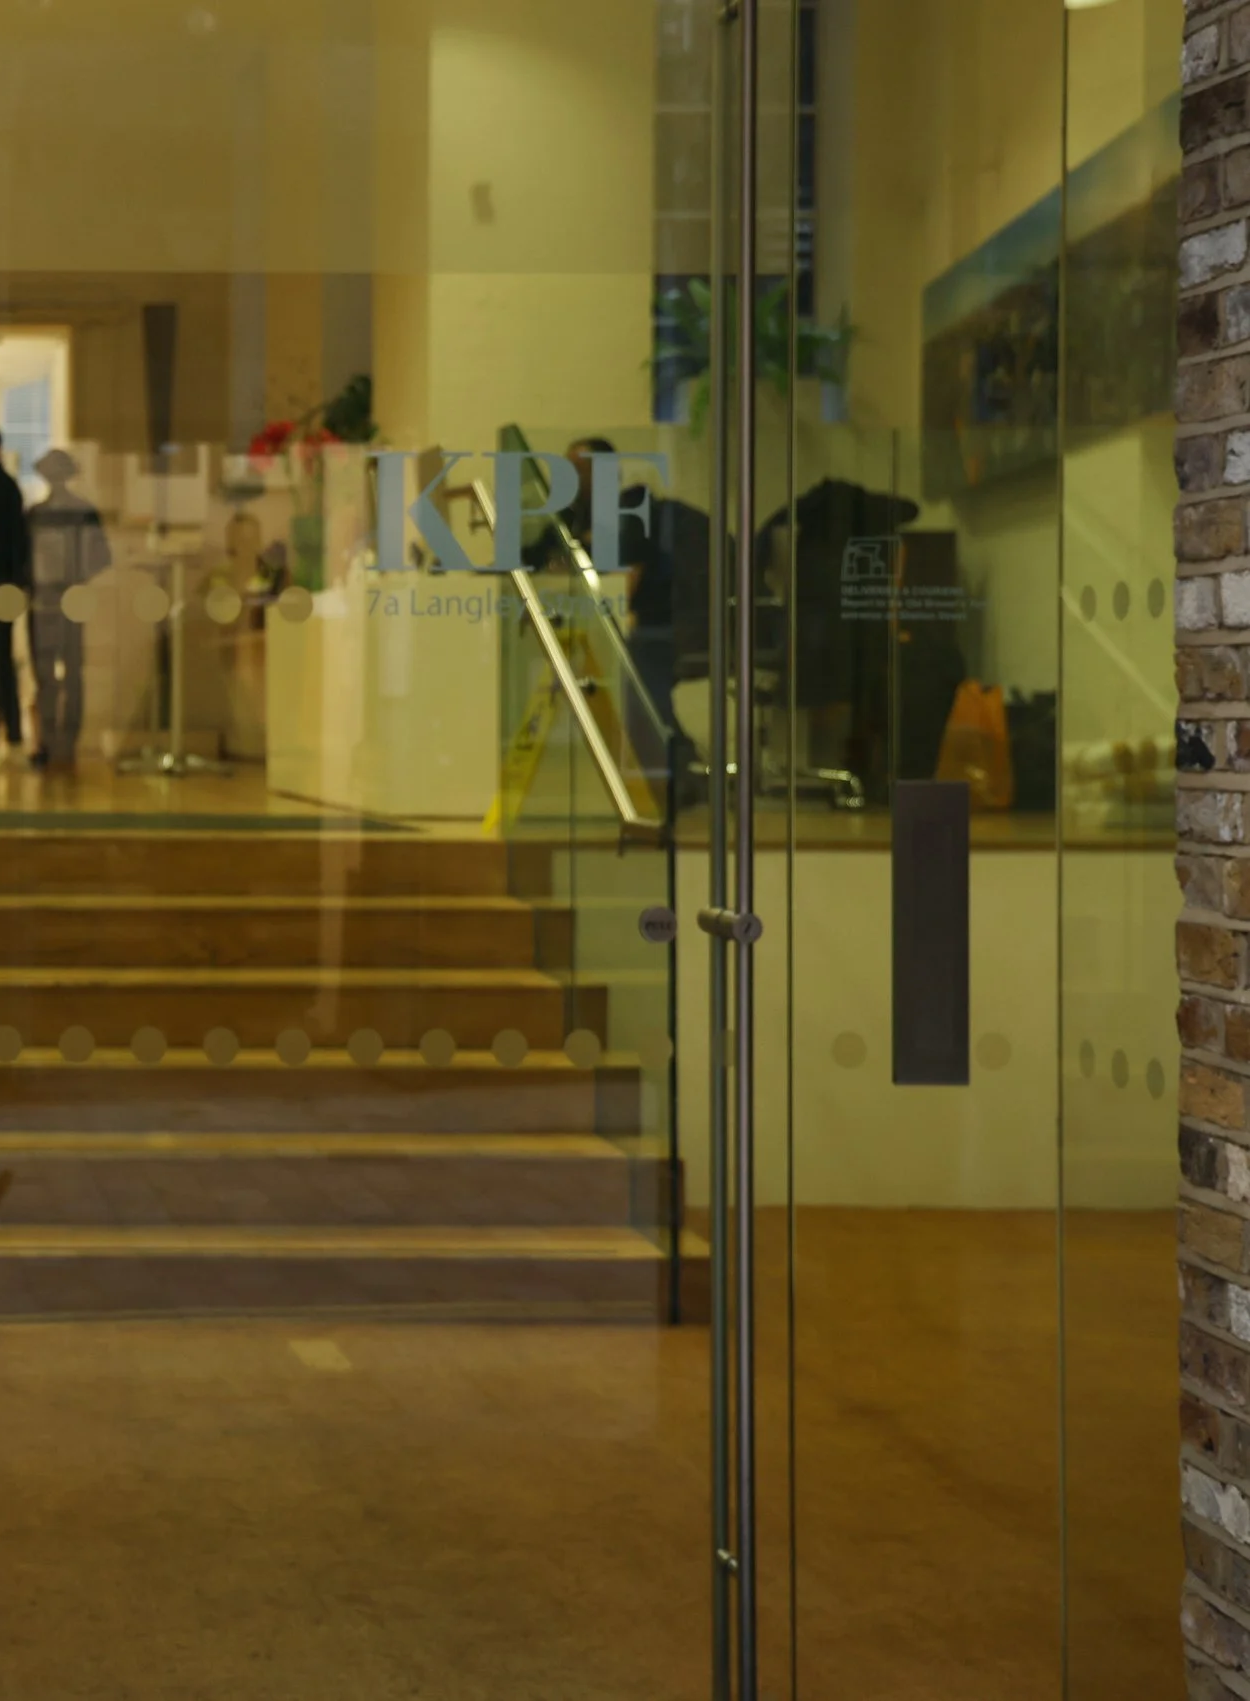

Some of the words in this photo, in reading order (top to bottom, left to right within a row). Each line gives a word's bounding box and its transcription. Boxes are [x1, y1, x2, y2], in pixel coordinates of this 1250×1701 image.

[366, 451, 670, 573] KPF
[367, 589, 400, 616] 7a
[410, 588, 526, 624] Langley
